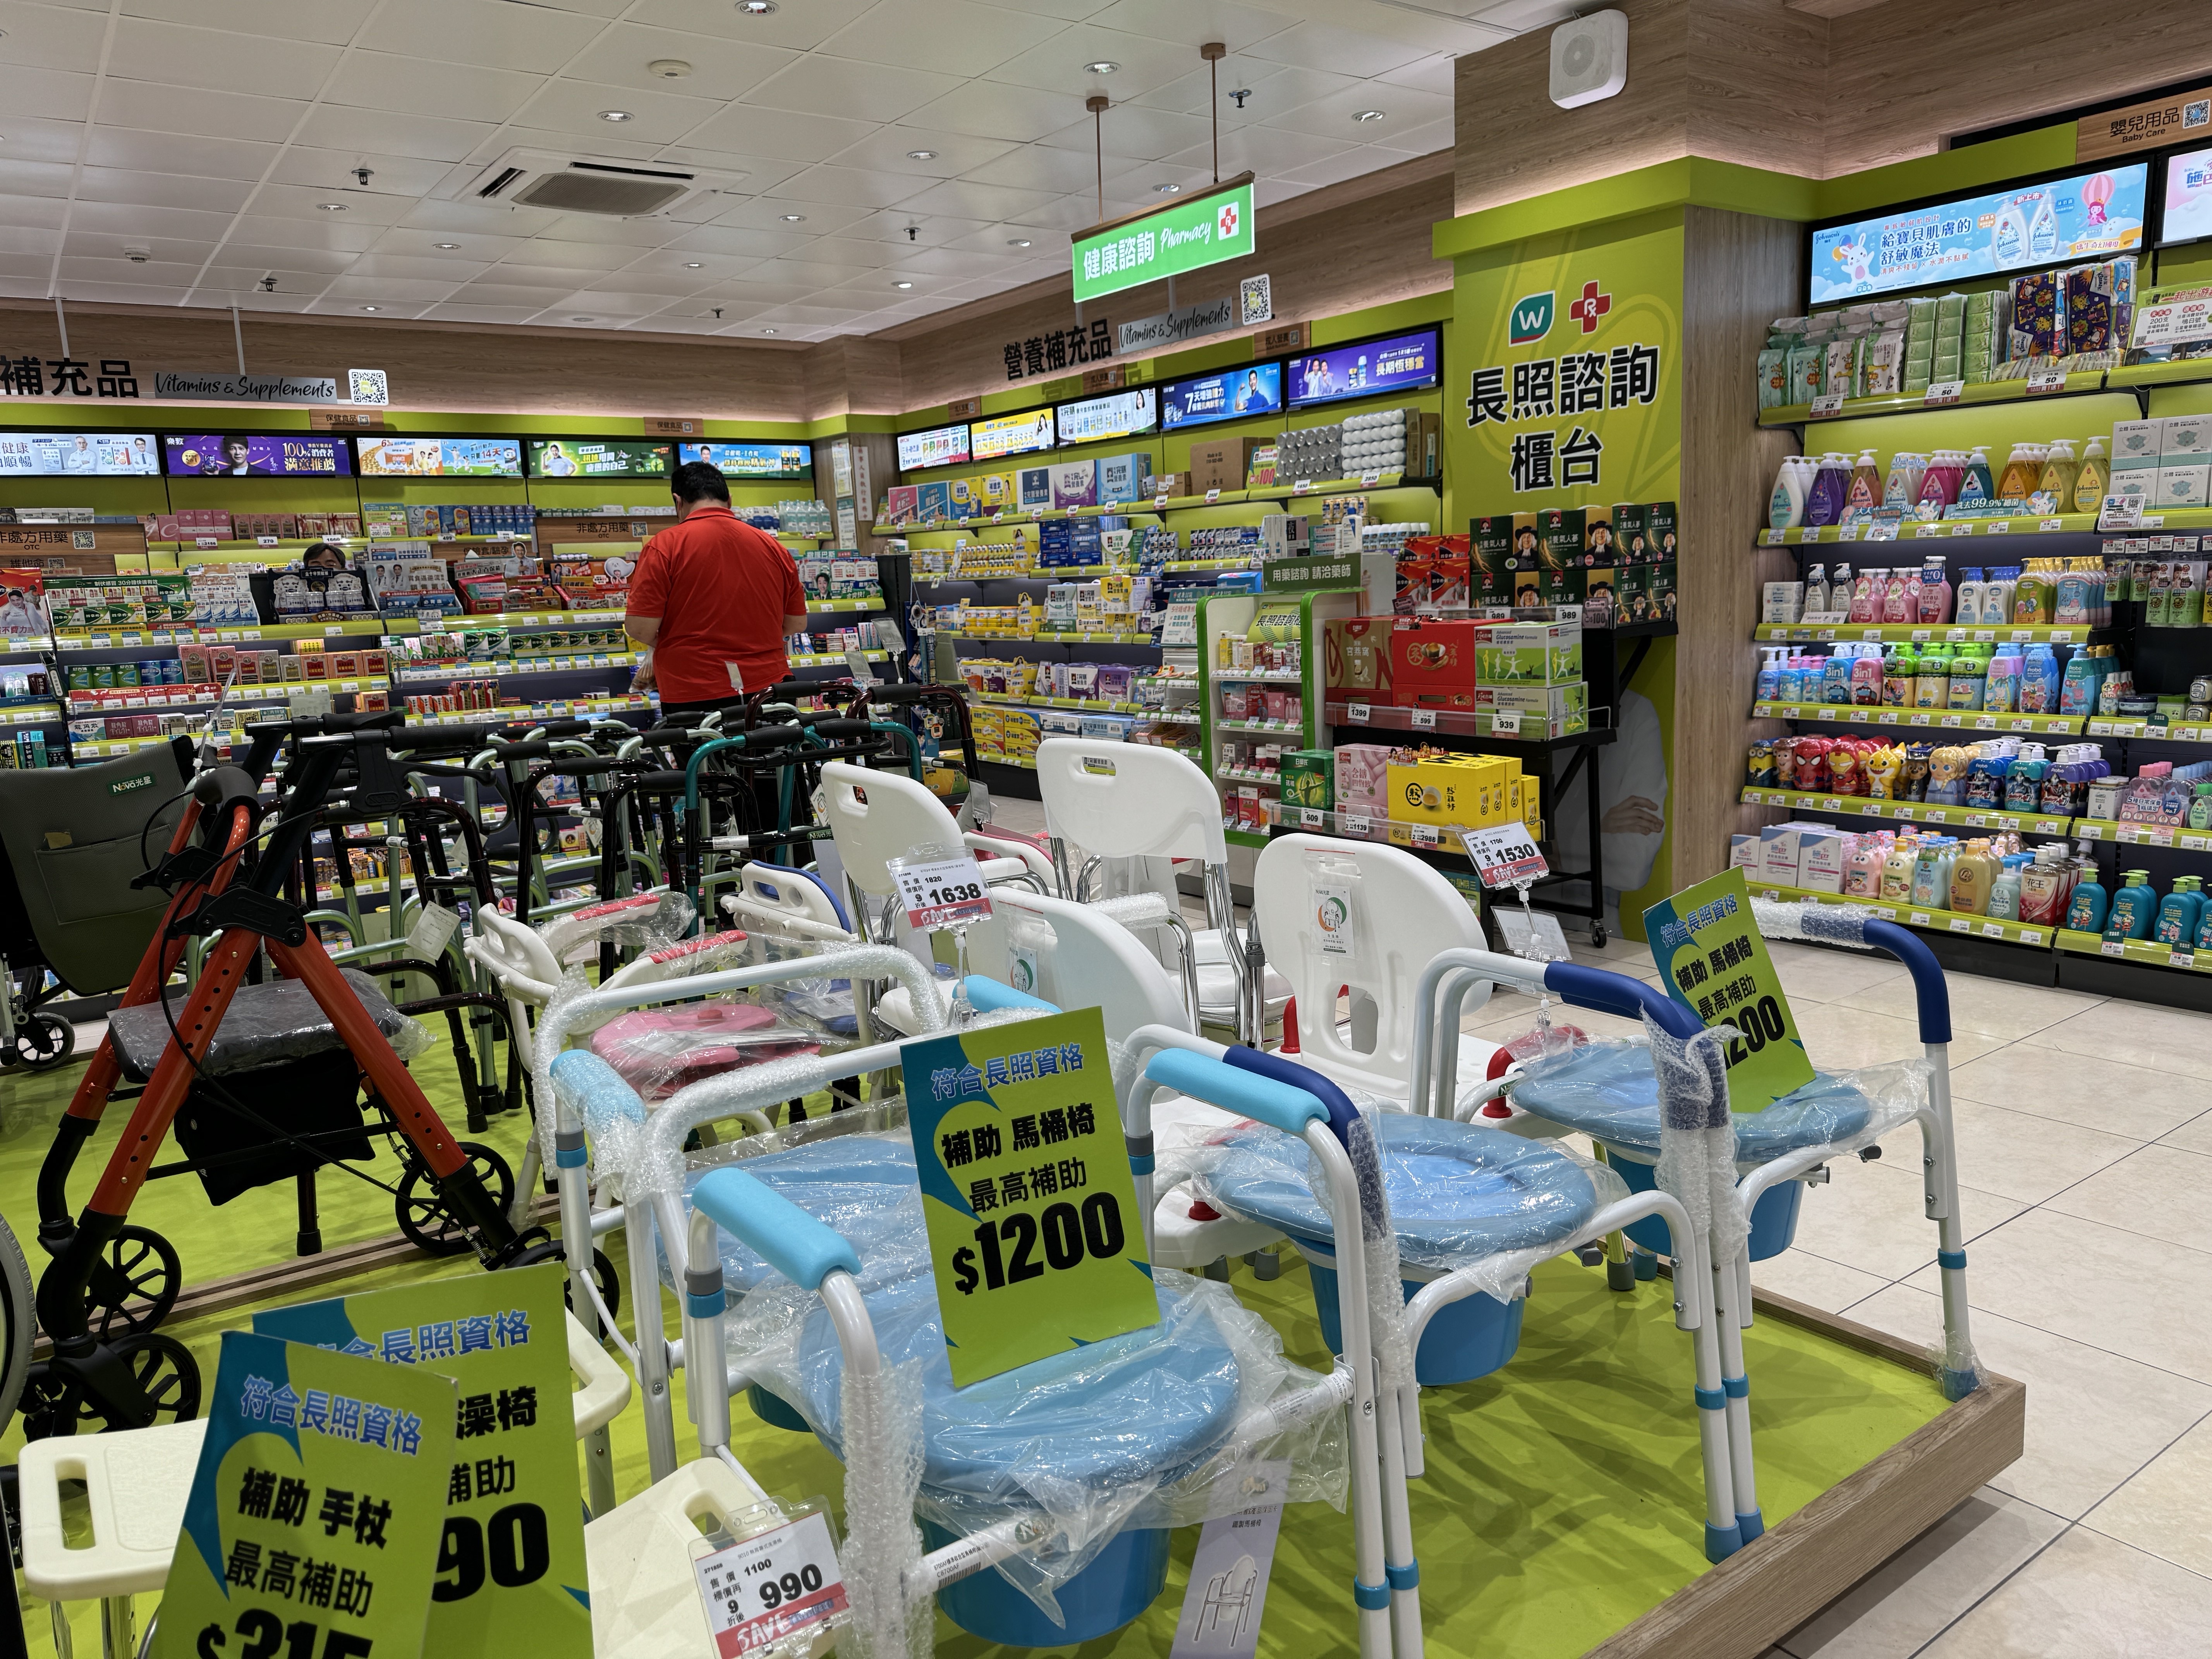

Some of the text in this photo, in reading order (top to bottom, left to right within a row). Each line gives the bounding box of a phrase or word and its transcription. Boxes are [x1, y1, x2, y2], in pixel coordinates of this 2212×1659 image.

[2110, 107, 2179, 137] 嬰兒用品
[2123, 128, 2166, 143] Baby Care
[2017, 192, 2040, 204] 新上市
[1881, 218, 1971, 249] 給寶貝肌膚的
[1084, 222, 1212, 282] 健康諮詢 Pharmacy
[1881, 242, 1939, 266] 舒敏魔法
[1881, 261, 1917, 275] 清爽不殘留
[1004, 304, 1231, 381] 營養補充品 Vitamins & Supplements
[0, 356, 335, 401] 補充品 Vitamins & Supplements
[1467, 343, 1660, 428] 長照諮詢
[326, 414, 357, 423] 保健食品
[1510, 427, 1604, 492] 櫃台
[576, 522, 630, 534] 非處方用藥
[10, 558, 44, 568] 維他命
[1273, 564, 1351, 582] 用藥諮詢 請洽藥師
[1346, 646, 1369, 657] 官燕窩
[1826, 666, 1844, 677] 3in1
[1853, 667, 1872, 678] 3in1
[1351, 709, 1367, 717] 1399
[1499, 721, 1514, 729] 939
[113, 776, 152, 792] Nova光星
[2128, 796, 2162, 807] 5種日常保養
[1496, 843, 1535, 864] 1530
[925, 876, 942, 884] 1820
[1492, 864, 1519, 880] SAVE
[929, 883, 982, 905] 1638
[2027, 879, 2045, 889] 花王
[914, 893, 923, 902] 9
[921, 906, 956, 926] SAVE
[1660, 893, 1739, 948] 符合長照資格
[1675, 934, 1754, 994] 補助 馬桶椅
[1697, 973, 1758, 1021] 最高補助
[1722, 995, 1786, 1070] 200
[931, 1042, 1085, 1101] 符合長照資格
[941, 1102, 1096, 1170] 補助 馬桶椅
[968, 1156, 1087, 1214] 最高補助
[951, 1190, 1125, 1296] $1200
[239, 1374, 424, 1458] 符合長照資格
[237, 1467, 393, 1550] 補助 手杖
[737, 1551, 749, 1559] 9010
[224, 1539, 374, 1619] 最高補助
[709, 1558, 772, 1589] 售價 1100
[937, 1563, 960, 1578] C8700AF
[713, 1582, 742, 1602] 標價再
[759, 1563, 823, 1609] 990
[727, 1599, 739, 1614] 9
[727, 1611, 745, 1626] 折後
[737, 1611, 793, 1650] SAVE
